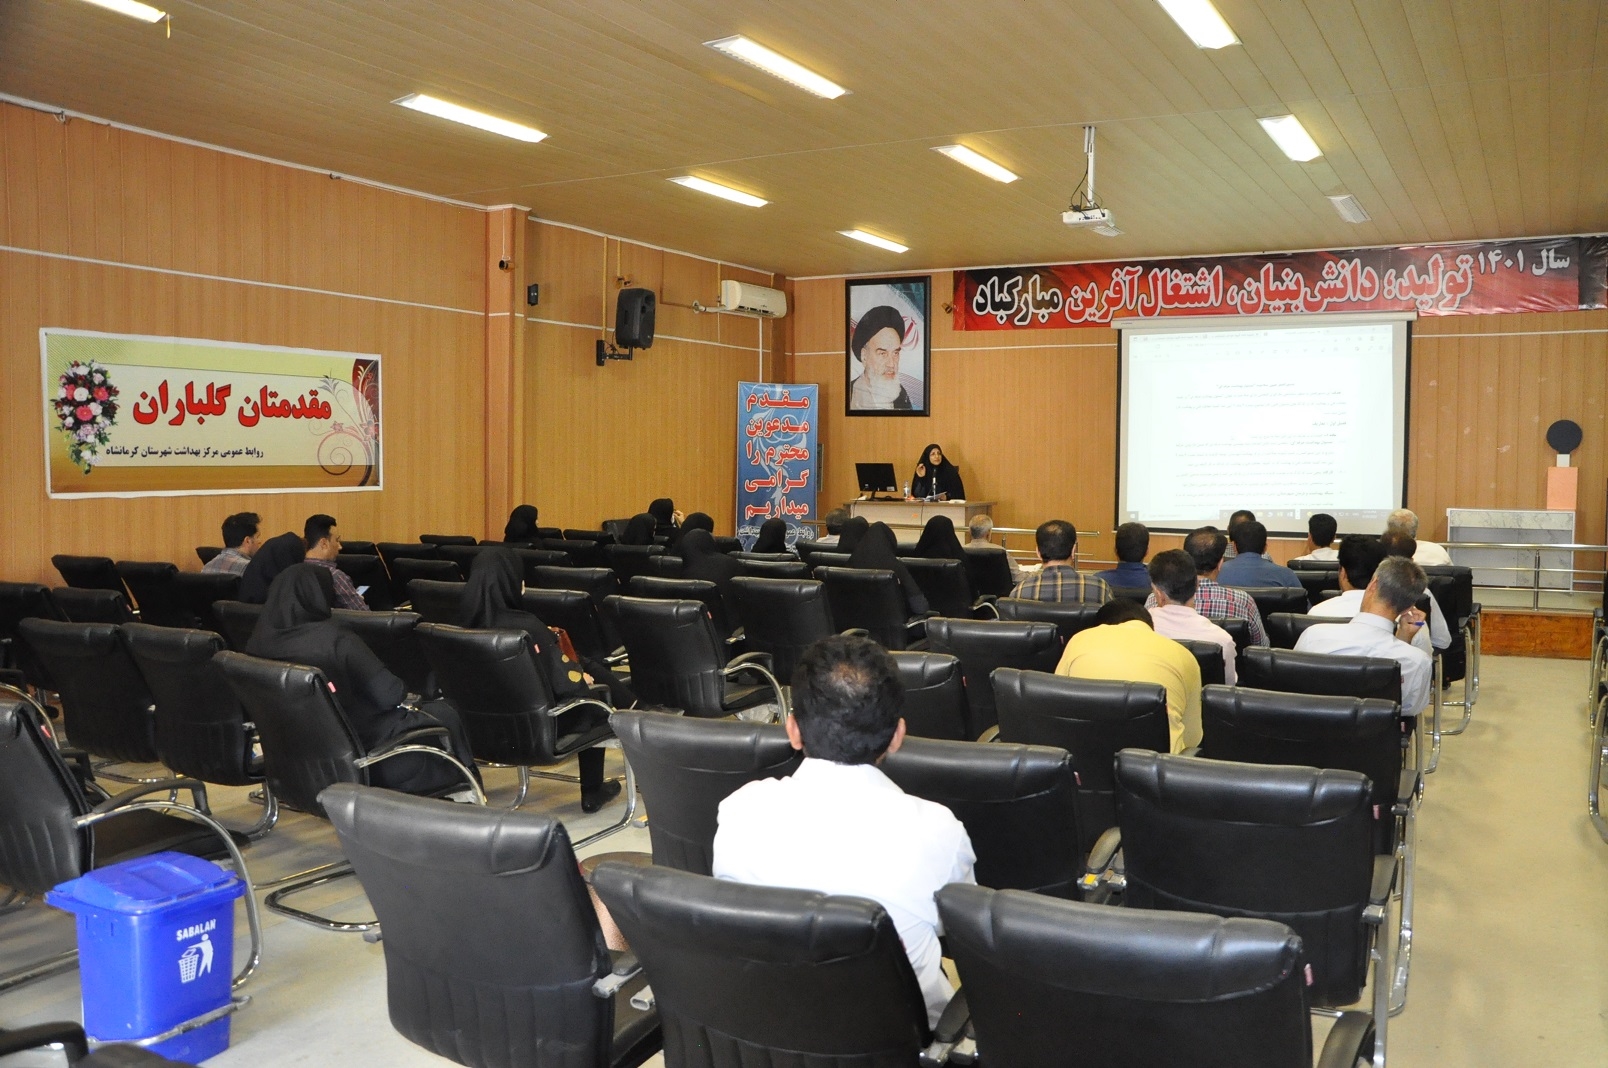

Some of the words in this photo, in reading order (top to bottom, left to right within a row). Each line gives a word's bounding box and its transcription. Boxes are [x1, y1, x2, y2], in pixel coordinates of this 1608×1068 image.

[1477, 248, 1525, 275] ۱۴۰۱
[1531, 248, 1571, 277] سال
[1064, 265, 1143, 324] آفرین
[1137, 264, 1223, 318] اشتغال
[132, 379, 232, 427] گلباران
[237, 384, 332, 428] مقدمتان
[746, 390, 810, 412] مقدم
[745, 417, 810, 438] مدعوین
[105, 446, 139, 459] کرمانشاه
[140, 446, 173, 459] شهرستان
[174, 446, 201, 458] بهداشت
[203, 446, 219, 459] مرکز
[220, 448, 243, 459] عمومی
[245, 446, 264, 459] روابط
[745, 440, 761, 466] را
[765, 443, 810, 466] محترم
[744, 468, 810, 493] گرامی
[744, 496, 810, 520] میداریم
[176, 918, 217, 942] SABALAN
